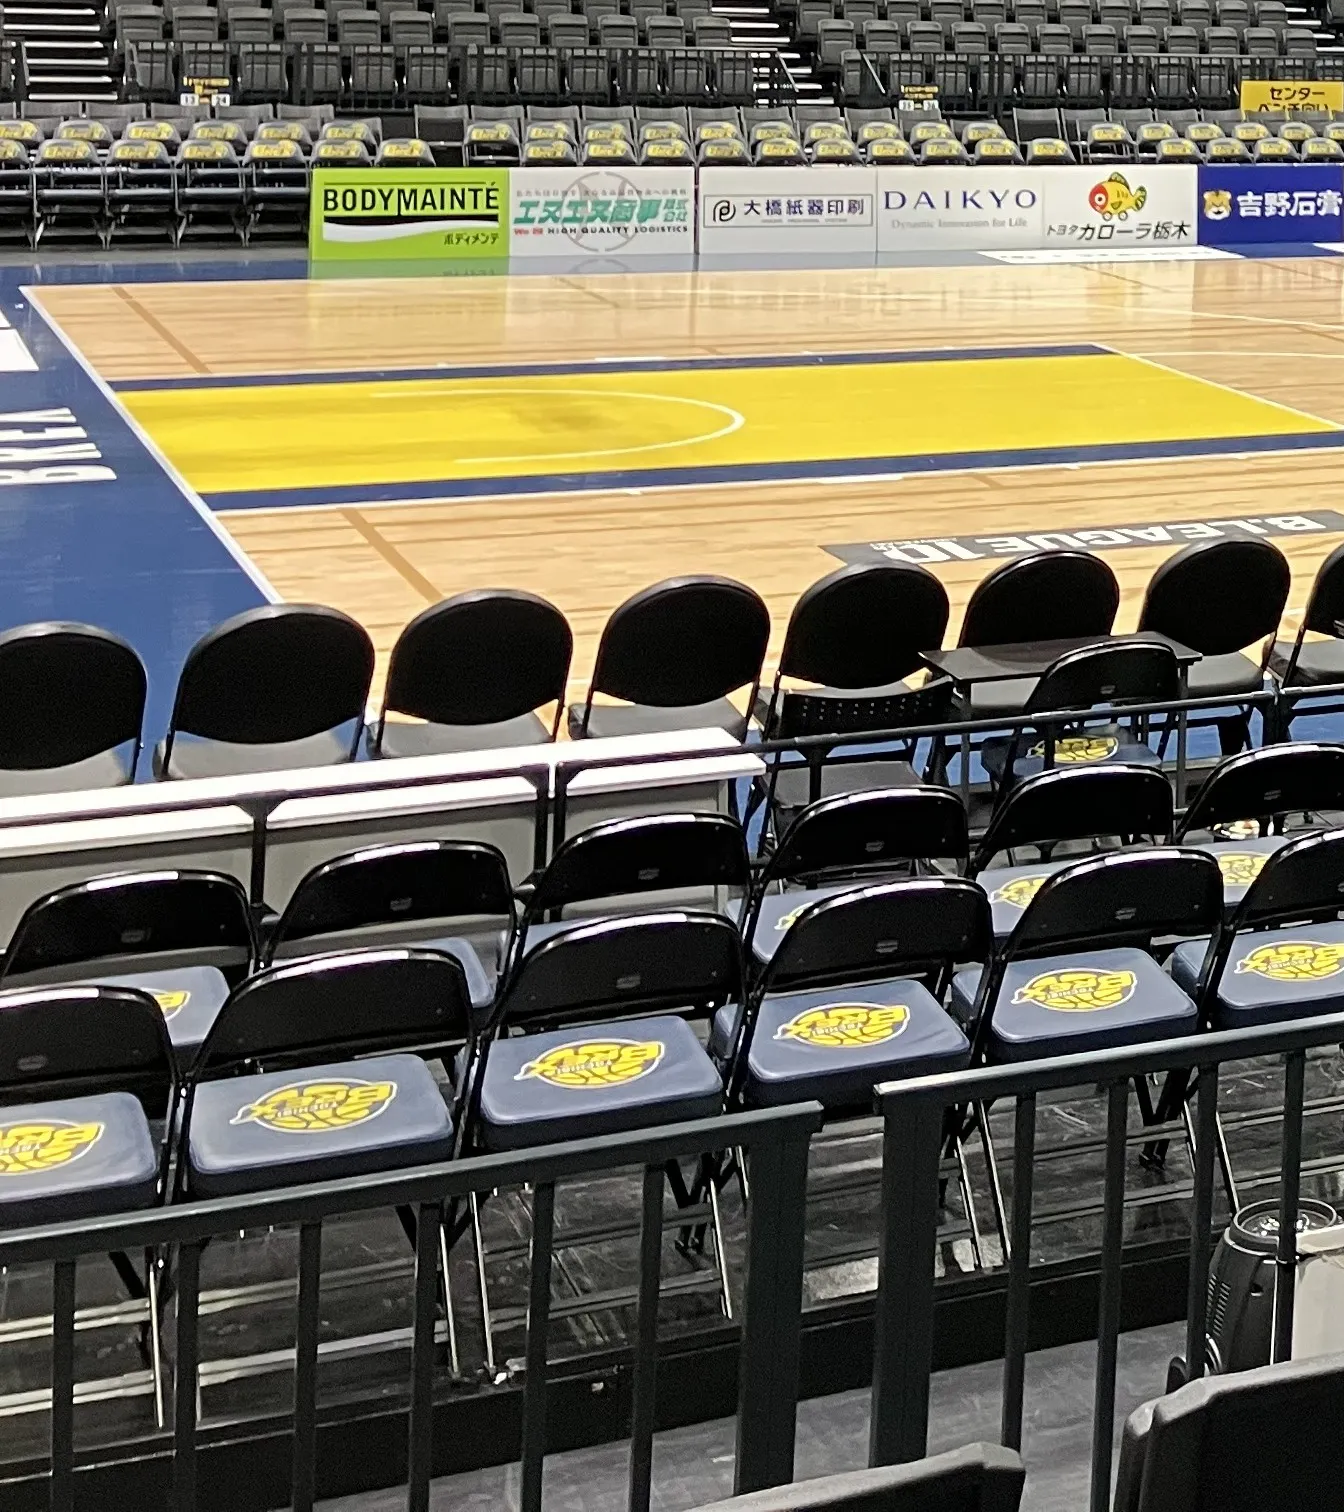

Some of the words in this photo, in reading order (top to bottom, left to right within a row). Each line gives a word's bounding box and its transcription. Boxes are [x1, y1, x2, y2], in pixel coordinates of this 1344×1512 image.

[1270, 87, 1325, 100] センター
[744, 199, 864, 216] 大橋紙器印刷
[884, 189, 1037, 210] DAIKYO
[1236, 190, 1343, 218] 吉野石膏
[443, 233, 499, 245] ボディメンテ
[548, 227, 577, 235] HIGH
[581, 226, 629, 234] QUALITY
[634, 225, 688, 234] LOGISTICS
[1047, 225, 1077, 236] トヨタ
[1077, 220, 1191, 240] カローラ栃木
[974, 515, 1327, 553] B.LEAGUE
